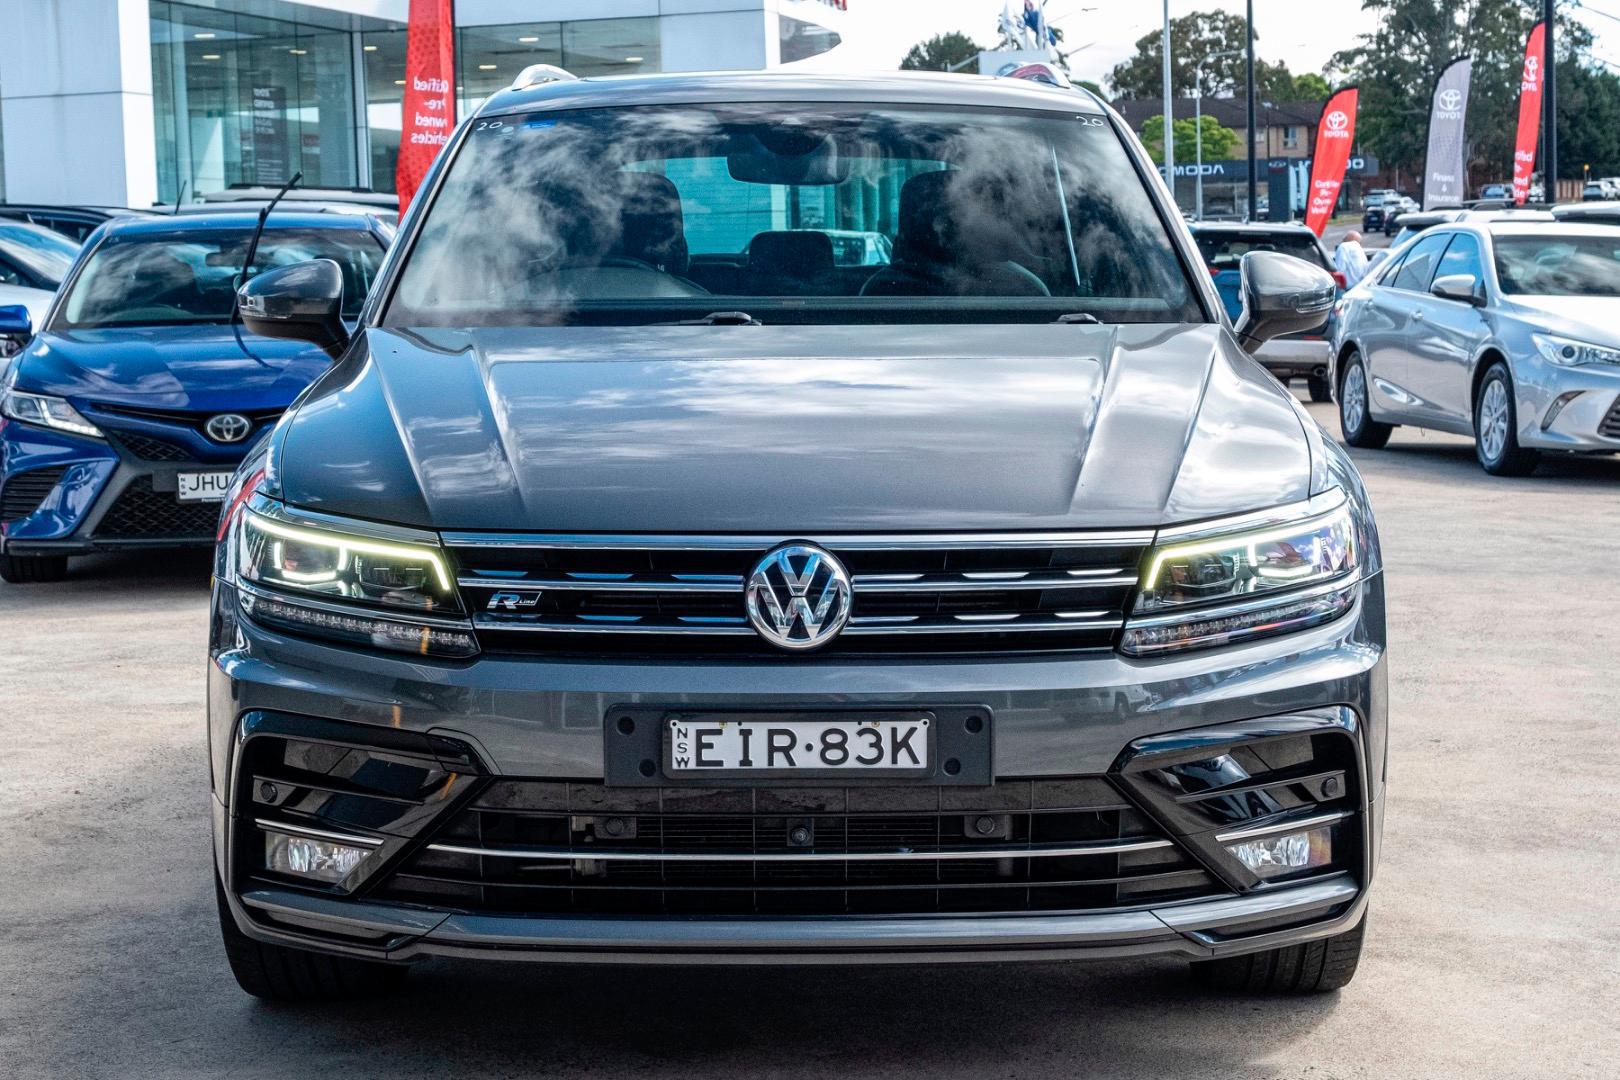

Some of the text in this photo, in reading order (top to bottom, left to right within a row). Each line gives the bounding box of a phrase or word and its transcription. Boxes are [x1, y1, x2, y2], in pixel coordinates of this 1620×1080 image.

[477, 121, 503, 131] 20
[1076, 115, 1104, 127] 20
[486, 593, 520, 609] R
[675, 727, 691, 768] NSW
